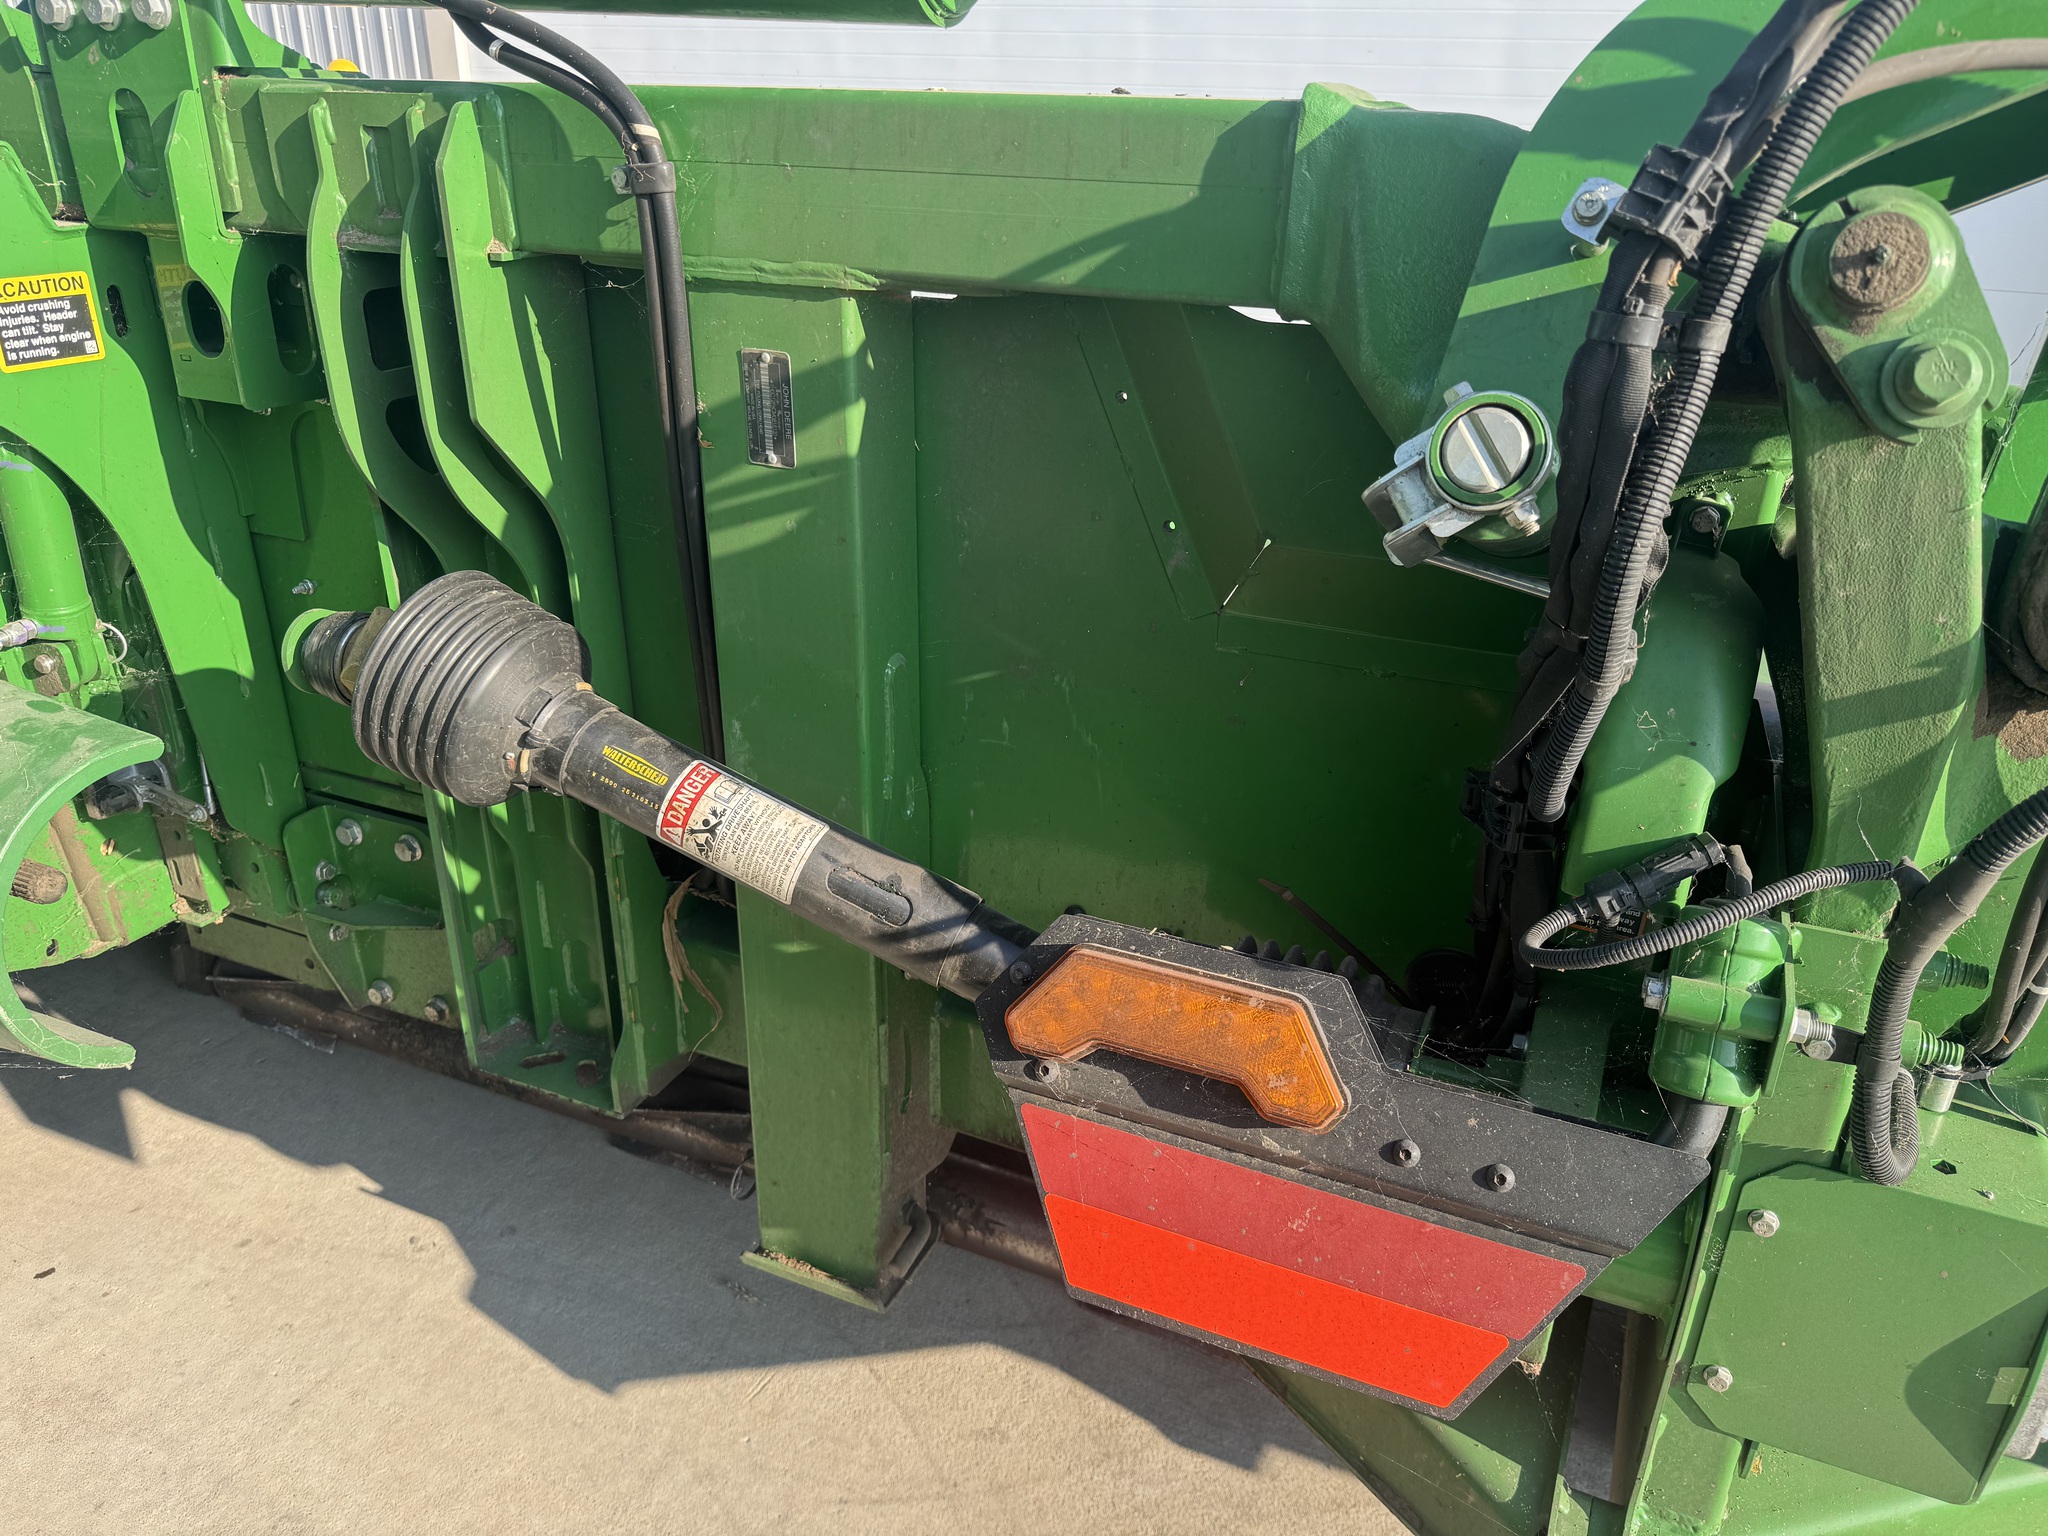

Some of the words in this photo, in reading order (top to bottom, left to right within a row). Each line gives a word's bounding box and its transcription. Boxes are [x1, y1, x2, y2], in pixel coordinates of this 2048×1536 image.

[3, 276, 84, 297] CAUTION
[0, 303, 26, 316] Avoid
[28, 299, 70, 312] crushing
[0, 315, 39, 327] injuries.
[43, 310, 78, 322] Header
[2, 328, 21, 338] can
[21, 325, 38, 336] tilt.
[42, 323, 64, 333] Stay
[4, 337, 30, 349] clear
[31, 335, 58, 346] when
[59, 330, 91, 343] engine
[7, 351, 17, 361] is
[19, 347, 60, 359] running.
[602, 745, 668, 786] WALTERSCHEID
[600, 776, 618, 788] 2500
[666, 765, 717, 826] DANGER
[714, 830, 727, 862] ROTATING
[724, 792, 754, 830] DRIVESHAFT
[730, 834, 742, 855] KEEP
[739, 810, 757, 834] AWAY!
[793, 822, 816, 850] ADAPTORS
[721, 840, 731, 861] CONTACT
[728, 829, 736, 840] CAN
[733, 813, 746, 829] CAUSE
[739, 825, 756, 852] OPERATE
[763, 840, 774, 855] BOTH
[771, 827, 782, 841] ENDS
[735, 851, 743, 865] NOT
[741, 840, 755, 869] DRIVESHAFT
[768, 838, 783, 860] GUARDS
[771, 836, 790, 866] DRIVESHAFT
[787, 849, 797, 863] PTO
[733, 863, 739, 871] DO
[781, 863, 790, 876] USE
[777, 875, 785, 887] NOT
[776, 887, 781, 895] DO
[1619, 917, 1635, 926] way
[1626, 908, 1641, 917] and
